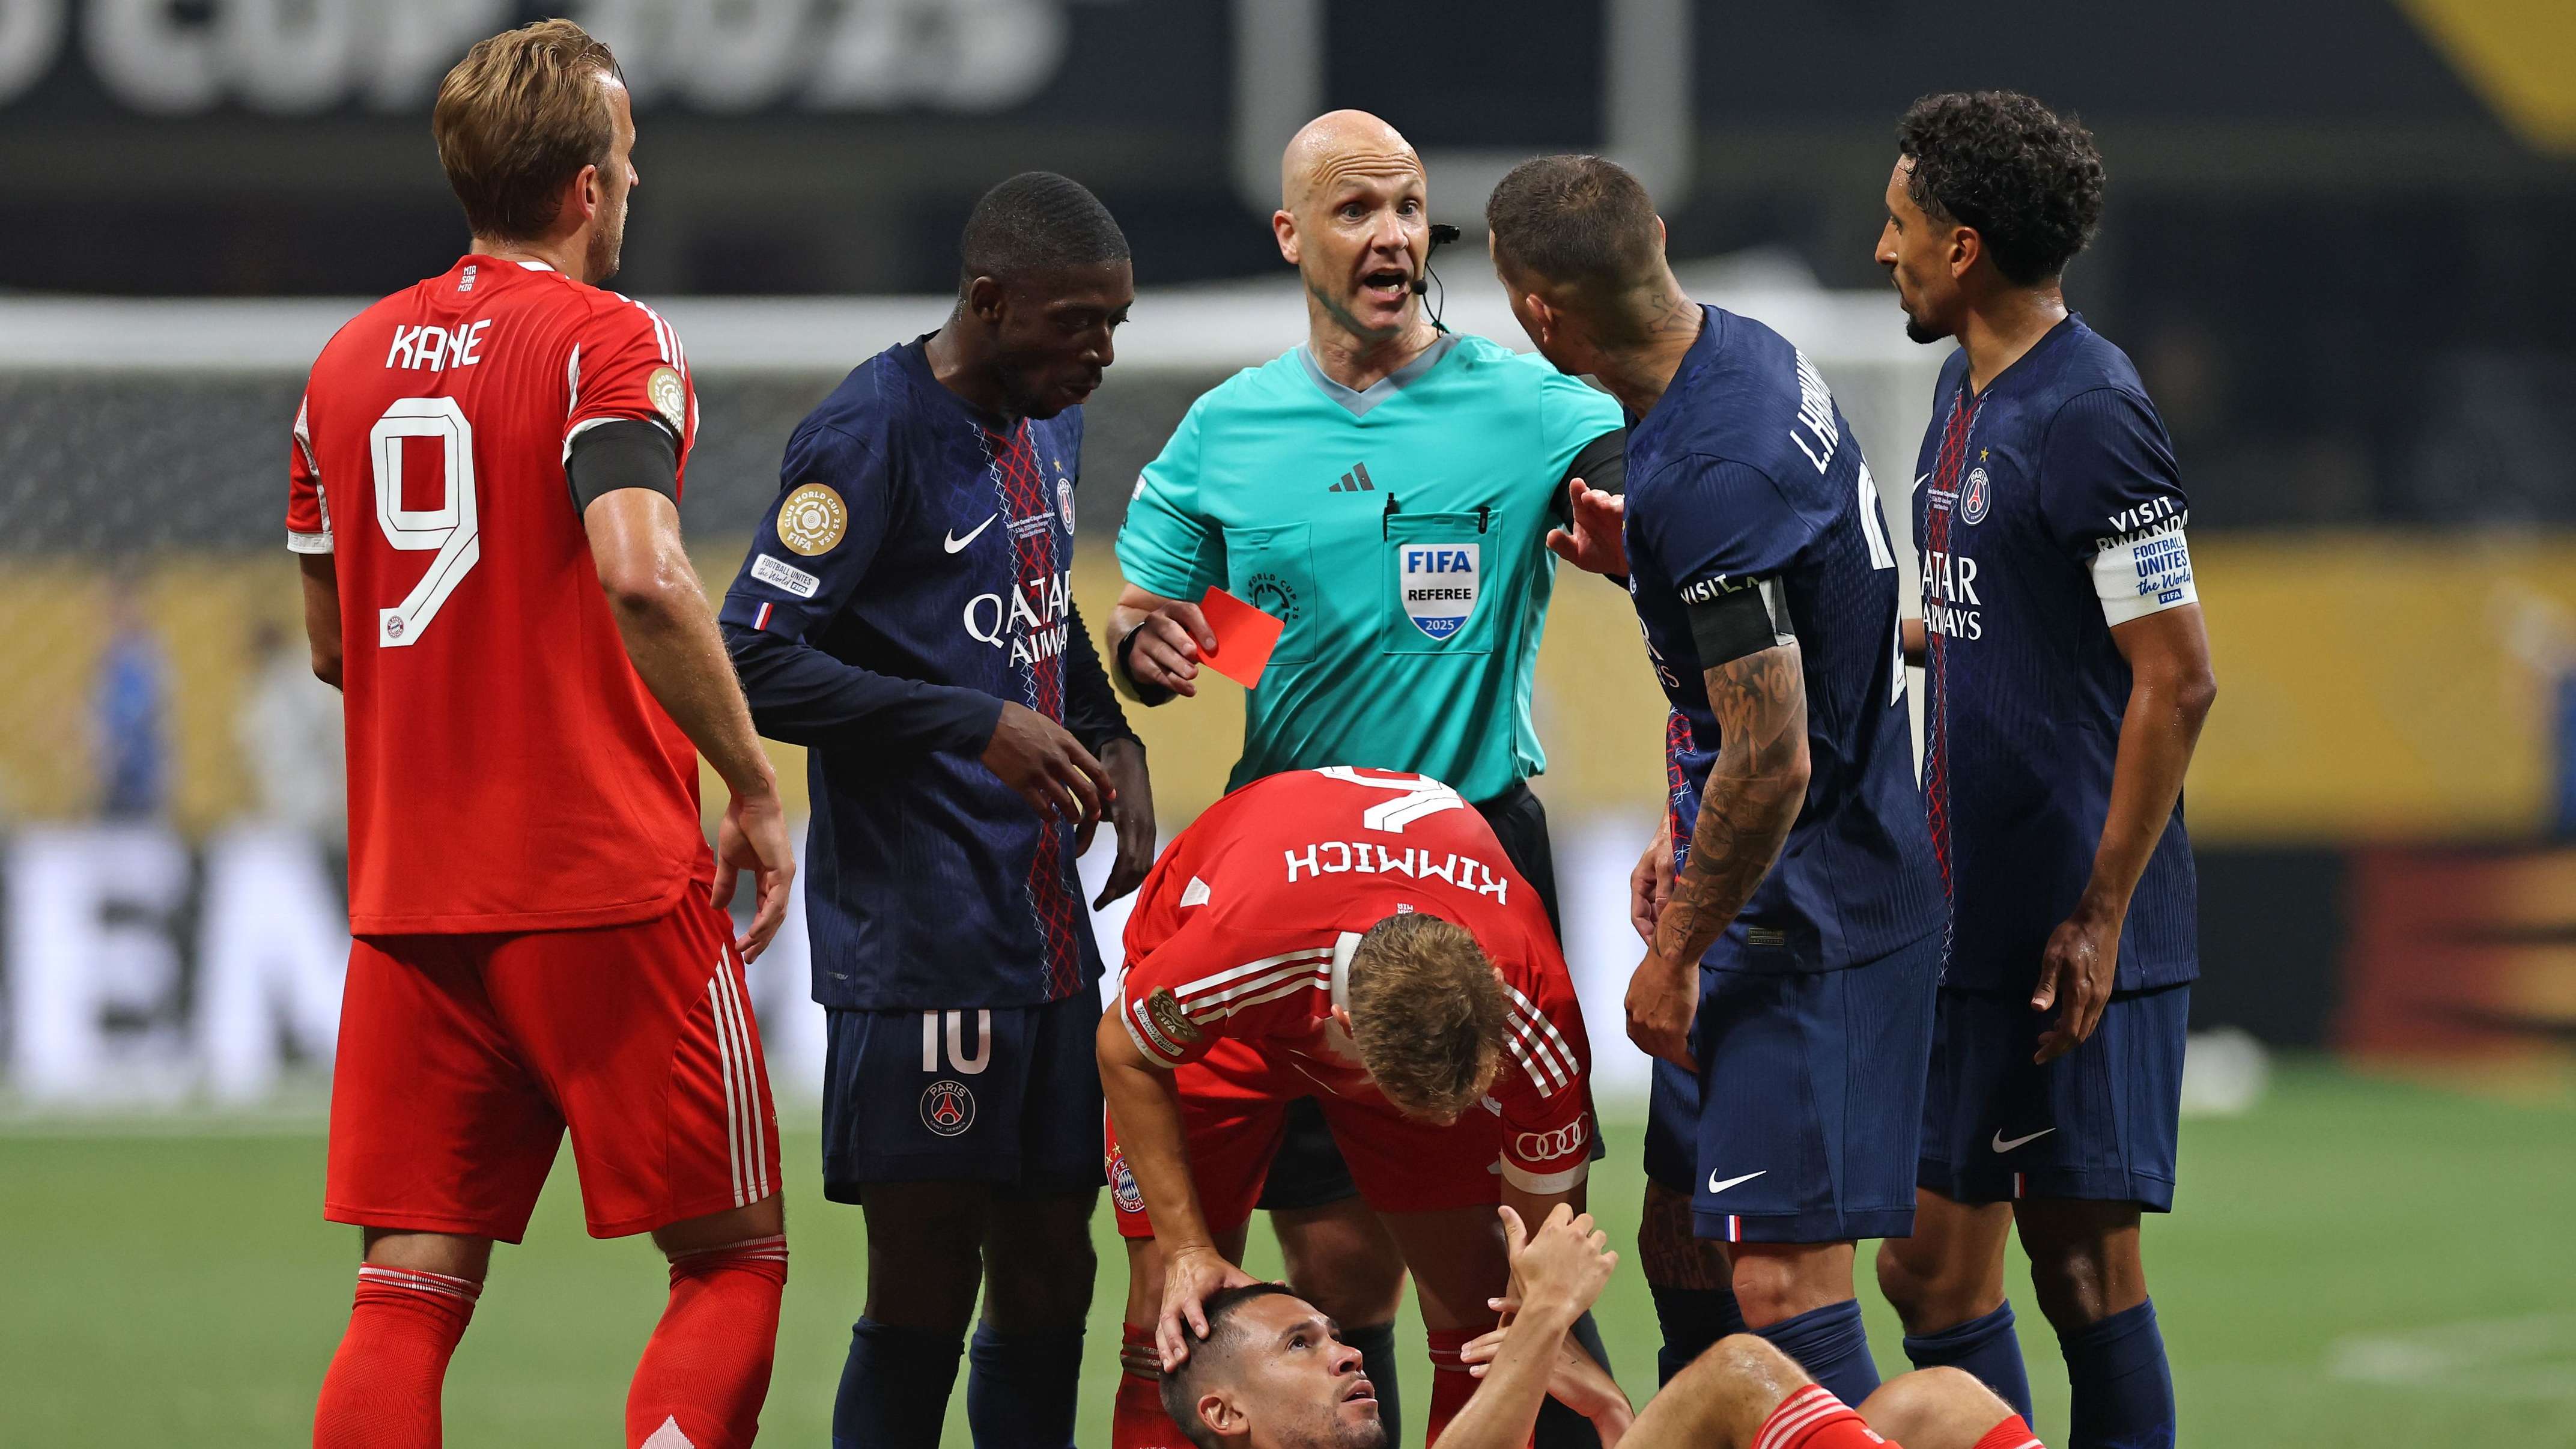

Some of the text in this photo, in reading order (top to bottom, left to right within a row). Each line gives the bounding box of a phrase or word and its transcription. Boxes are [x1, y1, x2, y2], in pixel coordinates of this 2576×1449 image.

[461, 275, 476, 284] SAN
[463, 265, 476, 276] MIA
[457, 283, 473, 292] MIA
[385, 318, 492, 372] KANE
[1971, 470, 1987, 485] PARIS
[369, 395, 481, 649] 9
[785, 491, 840, 546] CLUB WORLD CUP 25 USA
[2108, 496, 2174, 532] VISIT
[787, 531, 812, 551] FIFA
[2133, 536, 2184, 560] FOOTBALL
[762, 557, 813, 586] FOOTBALL UNITES
[1408, 551, 1472, 573] FIFA
[2136, 550, 2187, 578] UNITES
[758, 567, 807, 593] the World FIFA
[1681, 574, 1728, 605] VISIT
[1921, 549, 1981, 606] ATAR
[2136, 568, 2191, 596] the World
[1248, 573, 1299, 620] WORLD CUP 25
[1408, 588, 1472, 601] REFEREE
[2160, 589, 2183, 603] FIFA
[1426, 620, 1454, 631] 2025
[1284, 841, 1508, 906] KIMMICH
[1155, 1012, 1176, 1033] FIFA
[923, 1009, 991, 1075] 10
[930, 1083, 966, 1097] PARIS
